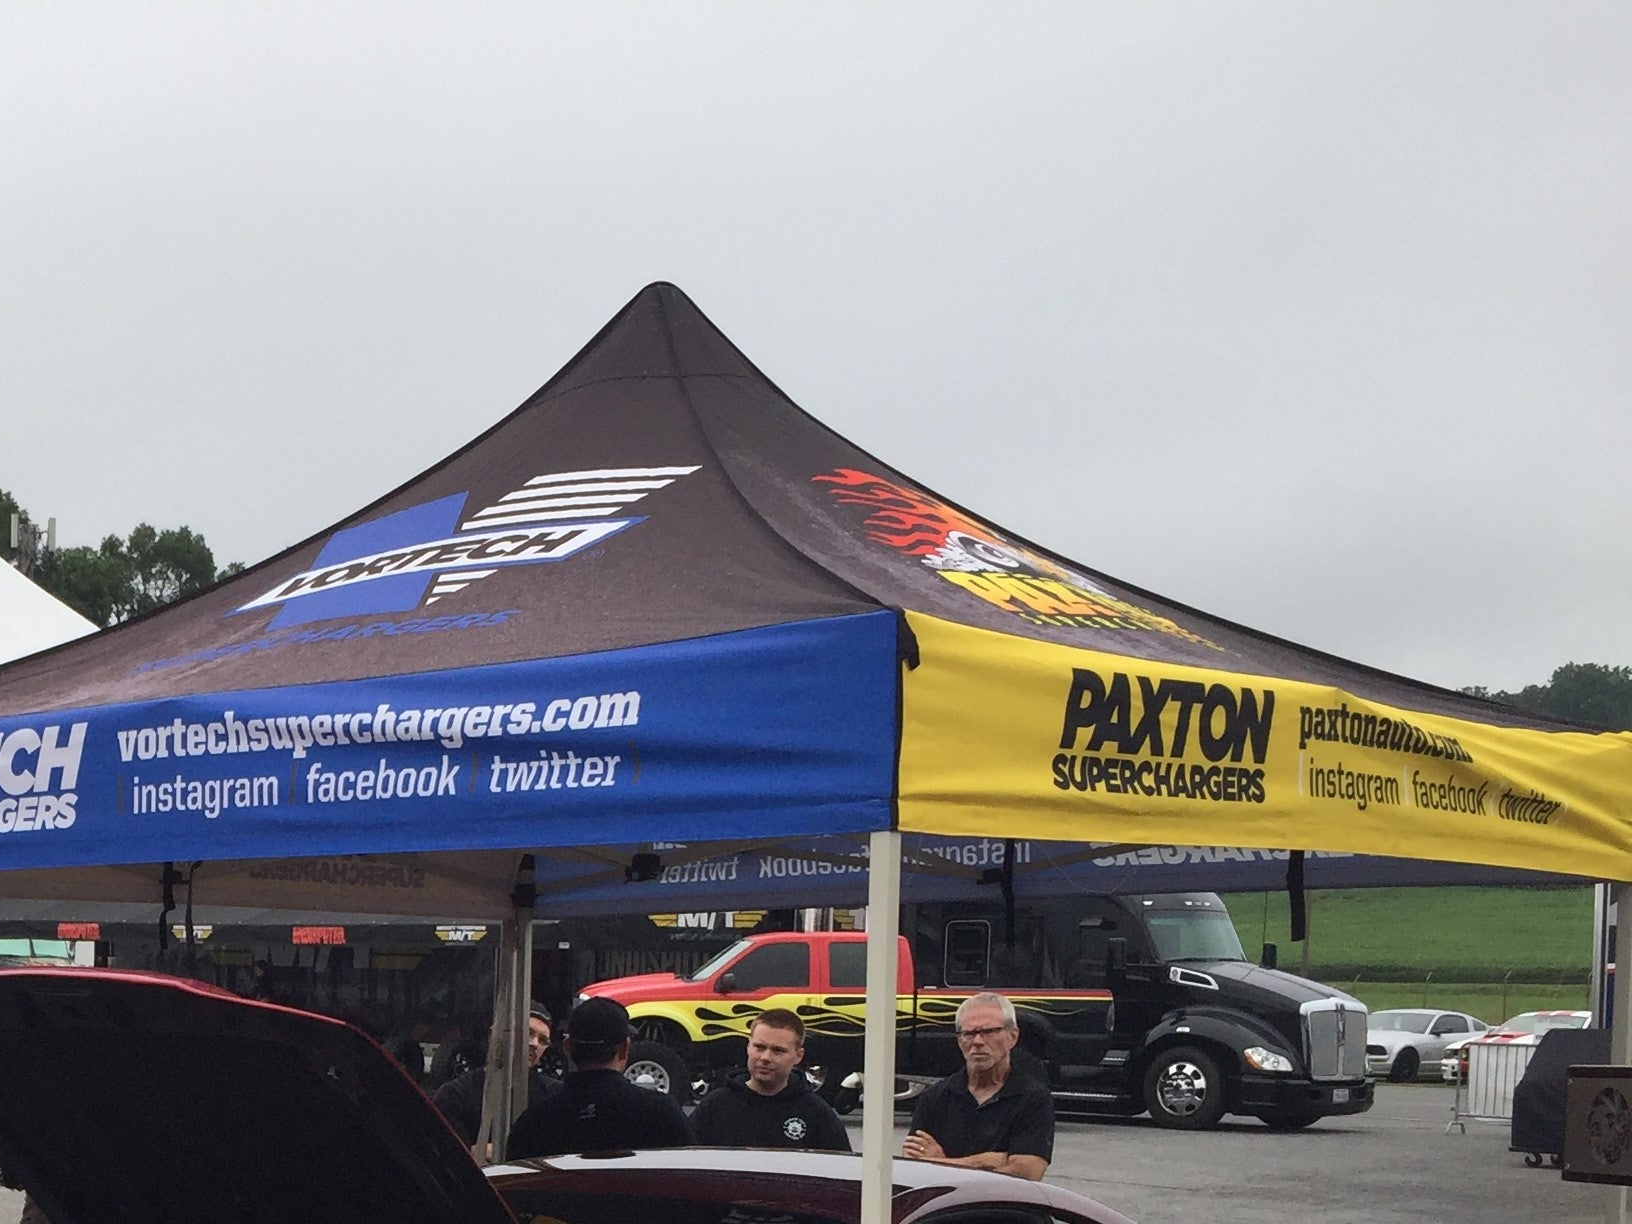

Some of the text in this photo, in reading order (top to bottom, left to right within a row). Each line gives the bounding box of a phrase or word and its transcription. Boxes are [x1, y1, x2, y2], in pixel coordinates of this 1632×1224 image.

[274, 529, 585, 599] VORTECH
[117, 691, 641, 762] vortechsuperchargers.com
[1059, 667, 1276, 764] PAXTON
[133, 749, 621, 818] instagram facebook twitter
[1052, 752, 1266, 804] SUPERCHARGERS
[1309, 757, 1561, 825] instagram facebook twitter
